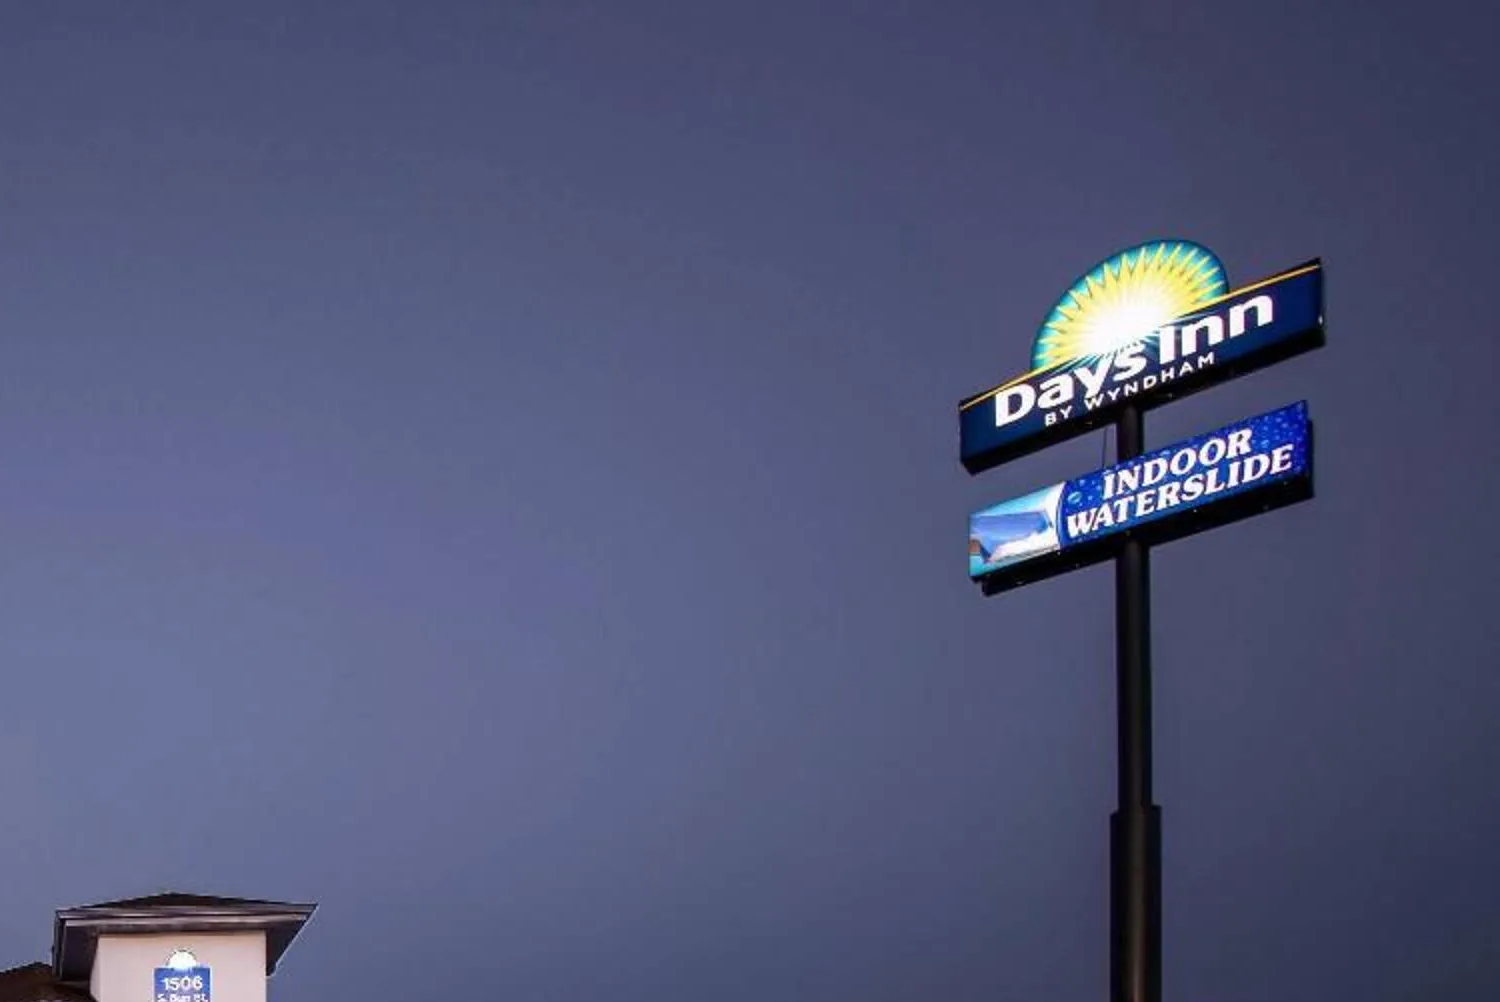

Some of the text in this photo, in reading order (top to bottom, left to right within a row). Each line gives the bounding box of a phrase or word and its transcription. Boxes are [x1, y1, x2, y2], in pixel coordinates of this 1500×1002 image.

[995, 295, 1274, 427] Days Inn
[1045, 352, 1215, 427] BY WYNDHAM
[1066, 444, 1294, 539] WATERSLIDE
[1102, 428, 1253, 500] INDOOR
[161, 975, 204, 992] 1506
